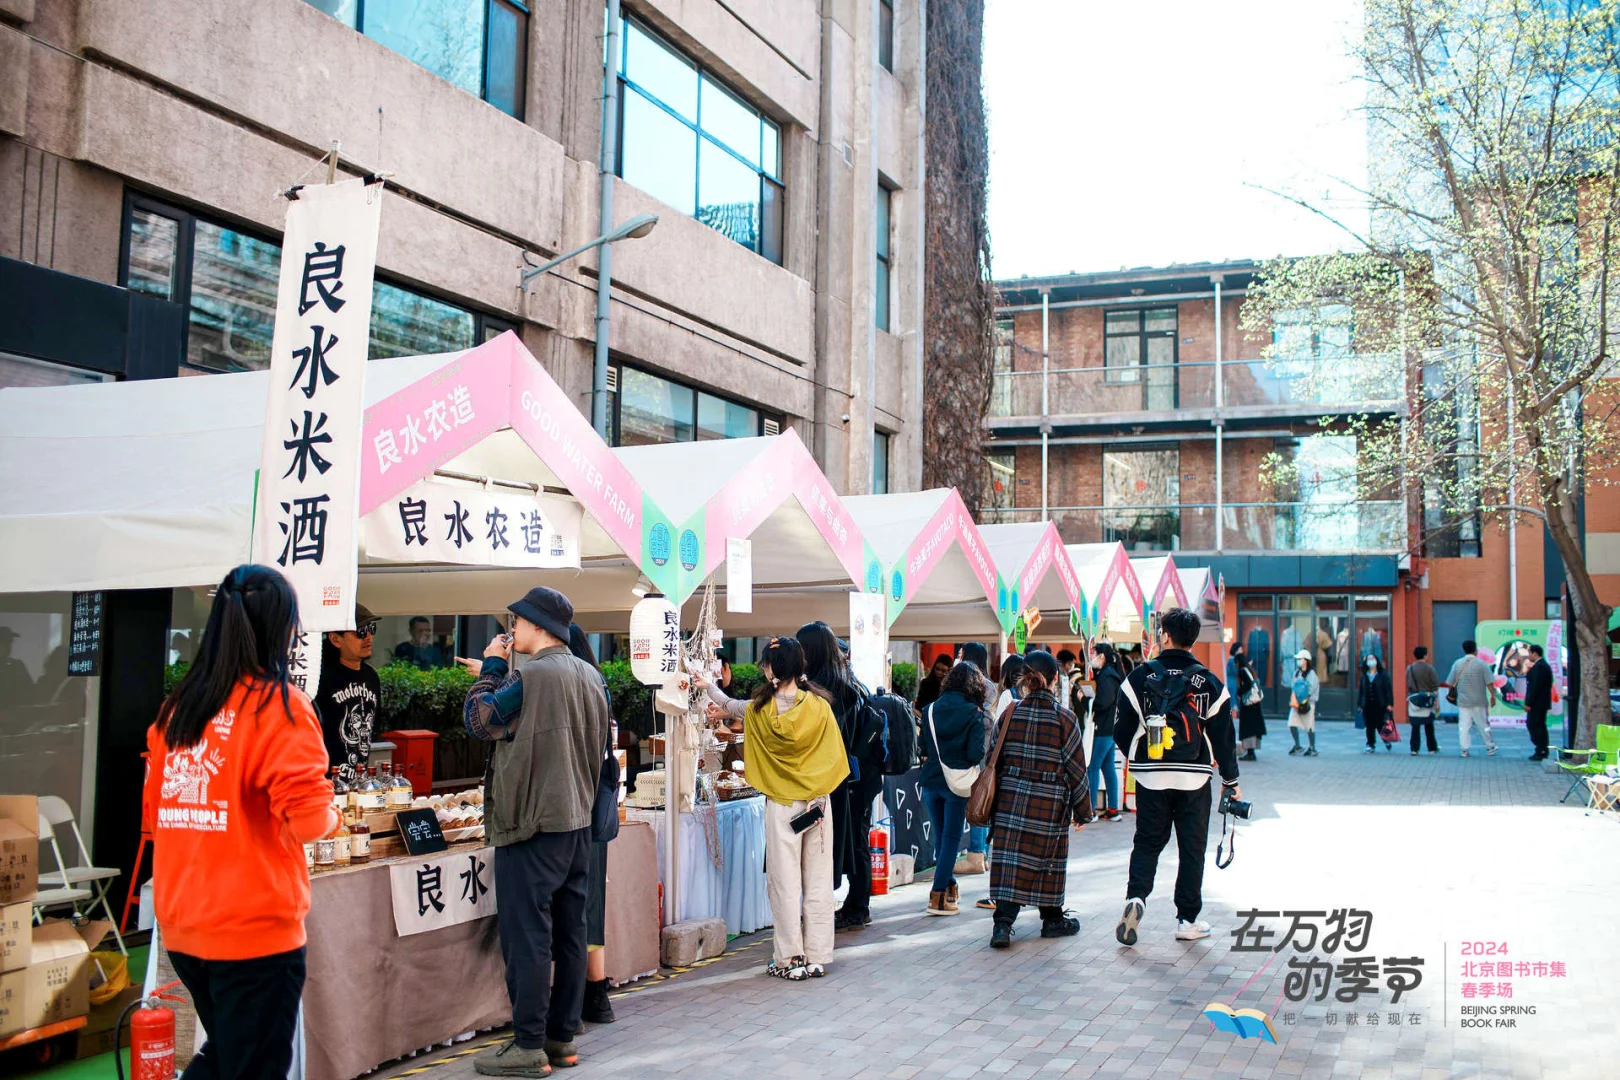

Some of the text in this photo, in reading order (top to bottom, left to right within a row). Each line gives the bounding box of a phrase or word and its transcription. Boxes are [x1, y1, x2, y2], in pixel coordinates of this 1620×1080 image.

[277, 242, 346, 567] 良水米酒
[373, 384, 476, 474] 良水农造
[521, 390, 635, 530] GOOD WATER FARM
[399, 497, 543, 553] 良水农造
[661, 611, 678, 672] 良水米酒
[417, 855, 488, 917] 良水
